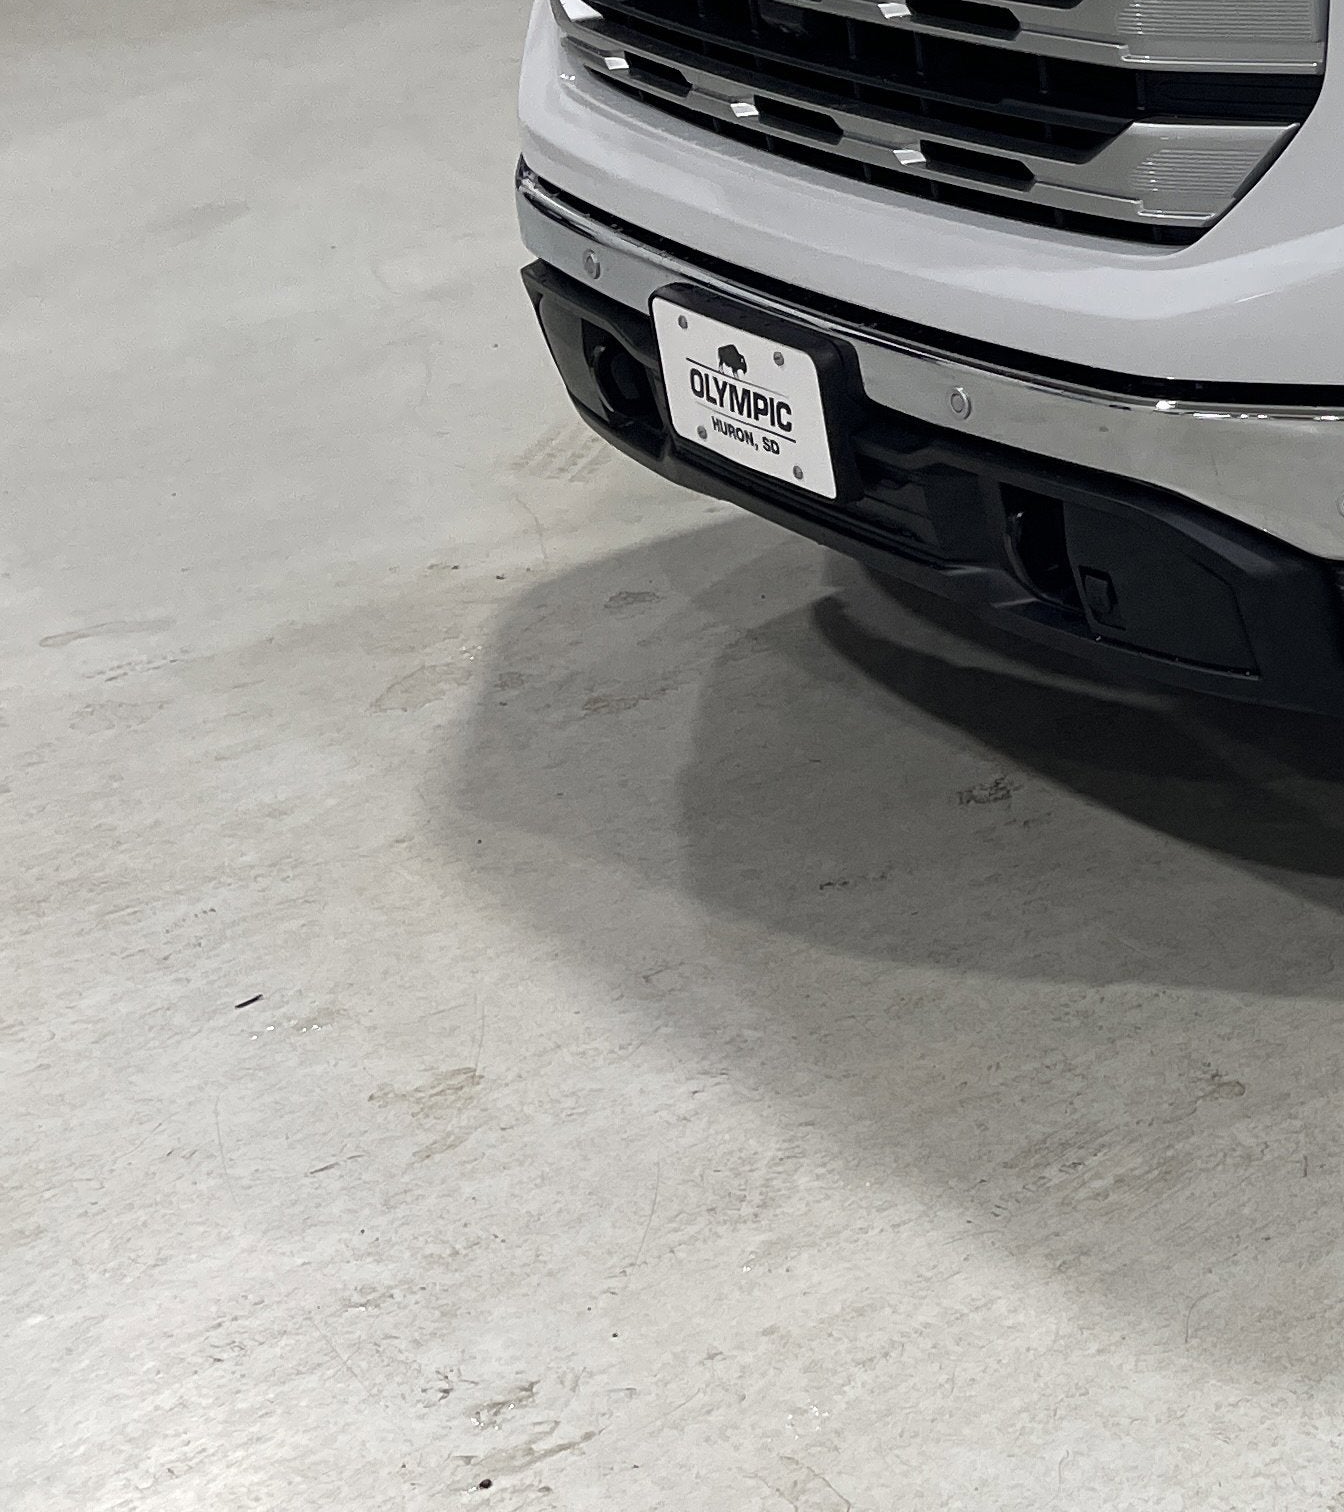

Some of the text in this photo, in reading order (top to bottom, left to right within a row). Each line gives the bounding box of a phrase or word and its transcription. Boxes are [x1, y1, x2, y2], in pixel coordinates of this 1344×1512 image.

[690, 367, 793, 433] OLYMPIC
[711, 415, 780, 455] HURON, SD
